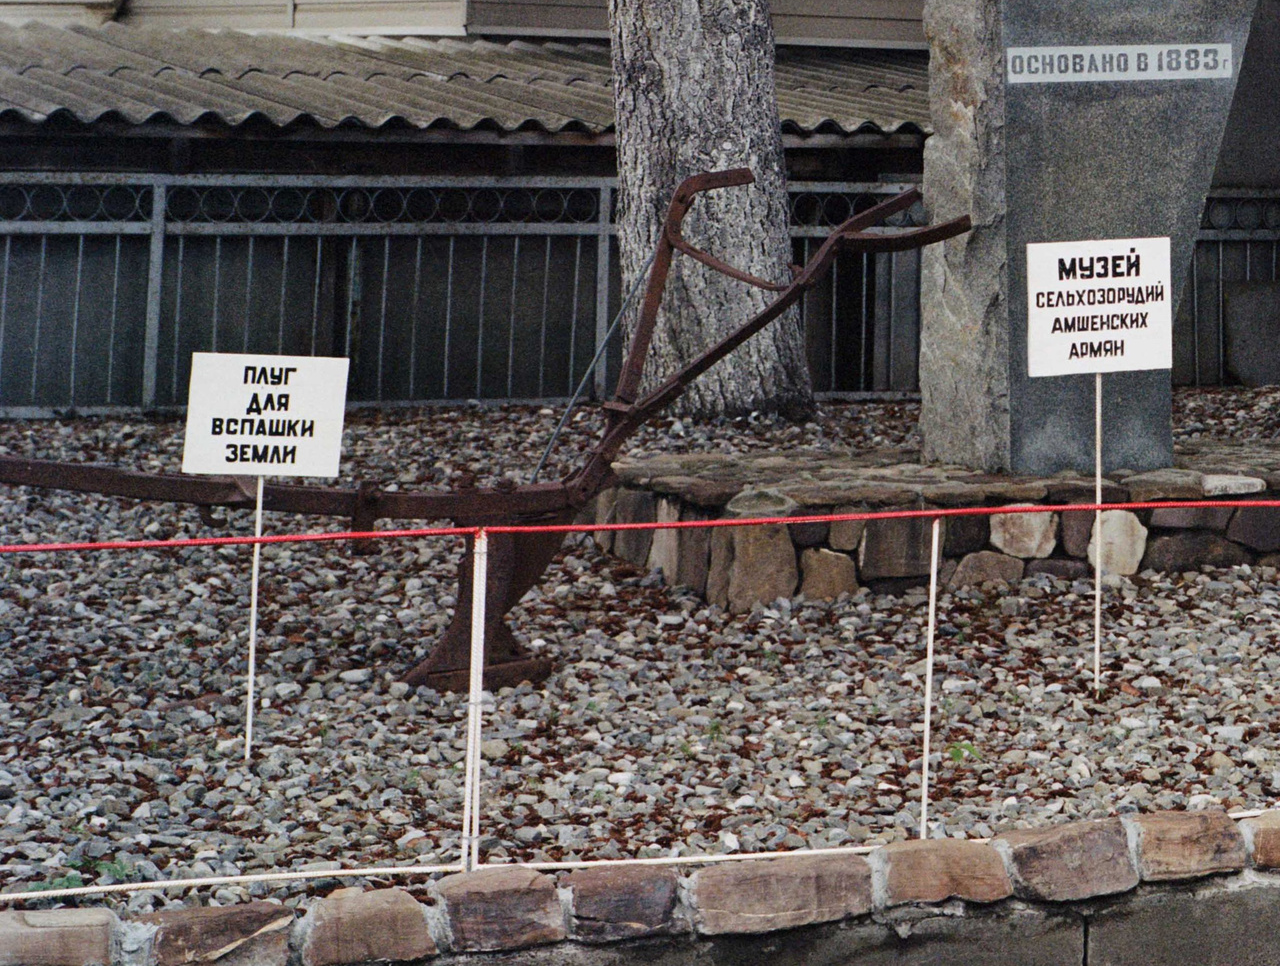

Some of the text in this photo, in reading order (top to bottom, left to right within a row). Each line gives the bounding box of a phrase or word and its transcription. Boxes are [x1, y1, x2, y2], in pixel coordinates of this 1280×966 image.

[1011, 52, 1129, 75] ОСНОВАНО
[1136, 52, 1149, 72] В
[1058, 247, 1140, 281] МУЗЕЙ
[1036, 280, 1164, 309] СЕЛЬХОЗОРУДИЙ
[1051, 312, 1149, 334] АМШЕНСКИХ
[1068, 339, 1125, 360] АРМЯН
[243, 365, 297, 386] ПЛУГ
[246, 392, 290, 416] ДЛЯ
[211, 417, 315, 438] ВСПАШКИ
[225, 443, 297, 464] ЗЕМЛИ
